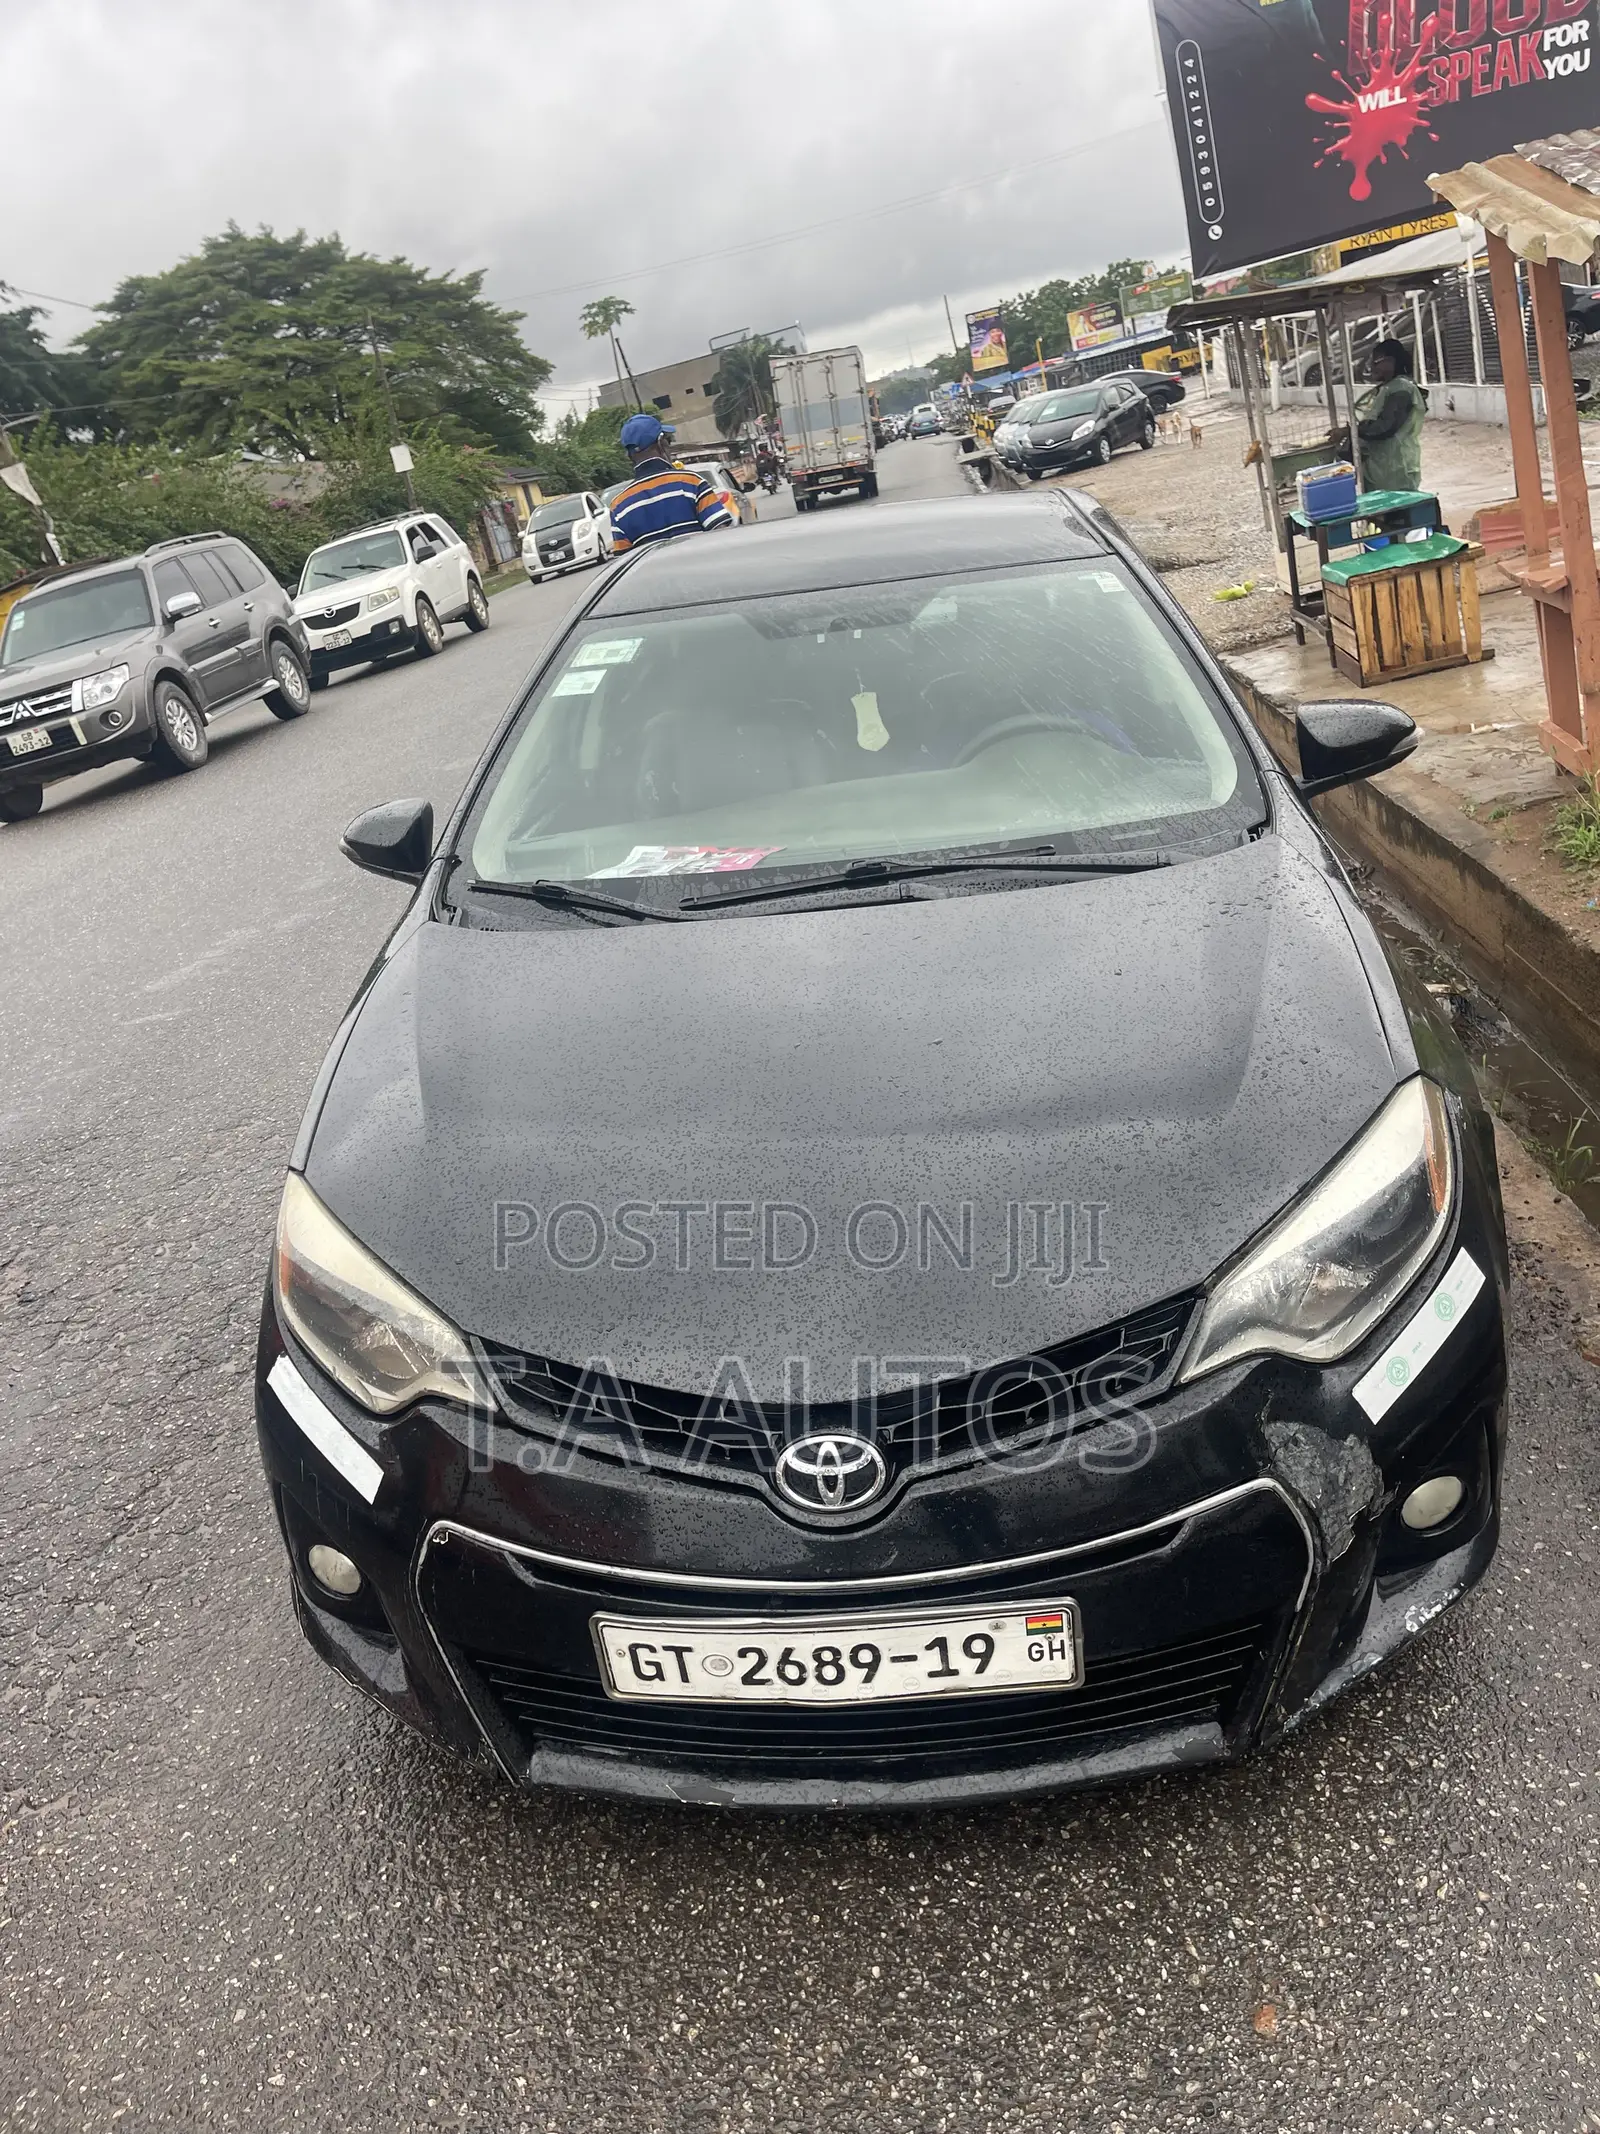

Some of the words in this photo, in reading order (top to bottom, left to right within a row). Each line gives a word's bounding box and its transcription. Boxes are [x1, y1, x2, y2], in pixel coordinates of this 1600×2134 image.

[1544, 20, 1590, 51] FOR
[1428, 30, 1547, 108] SPEAK
[1542, 48, 1591, 80] YOU
[1358, 86, 1407, 113] WILL
[13, 737, 51, 754] 2493-12
[628, 1643, 694, 1683] GT
[738, 1632, 996, 1686] 2689-19
[1028, 1640, 1066, 1662] GH
